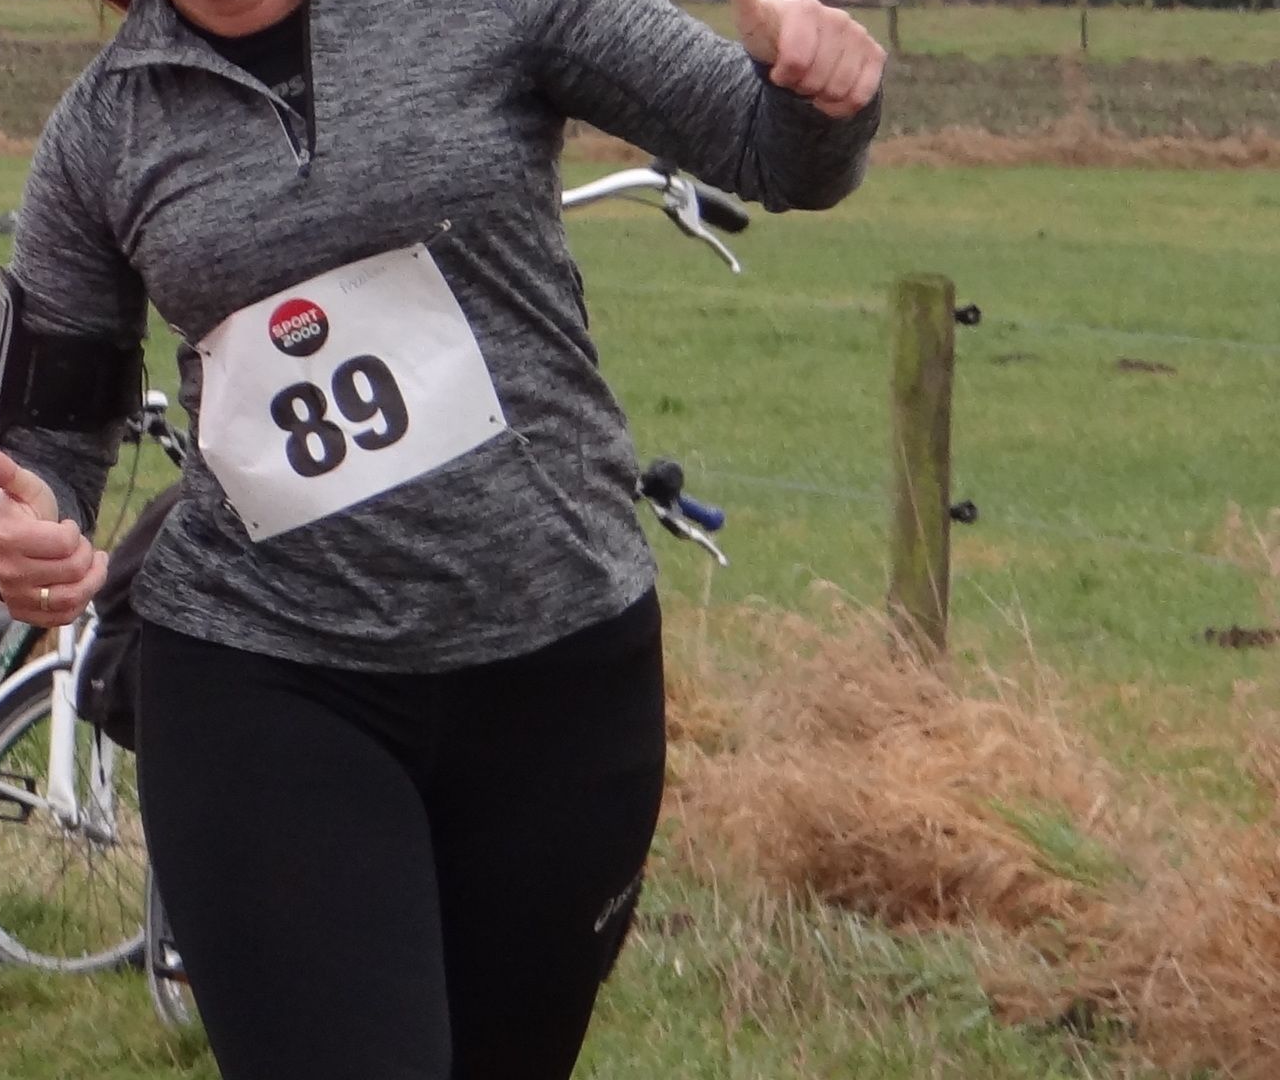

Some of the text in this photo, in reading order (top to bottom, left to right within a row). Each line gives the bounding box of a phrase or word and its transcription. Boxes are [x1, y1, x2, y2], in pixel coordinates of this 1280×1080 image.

[272, 308, 318, 338] SPORT
[281, 322, 321, 348] 2000
[270, 355, 409, 477] 89
